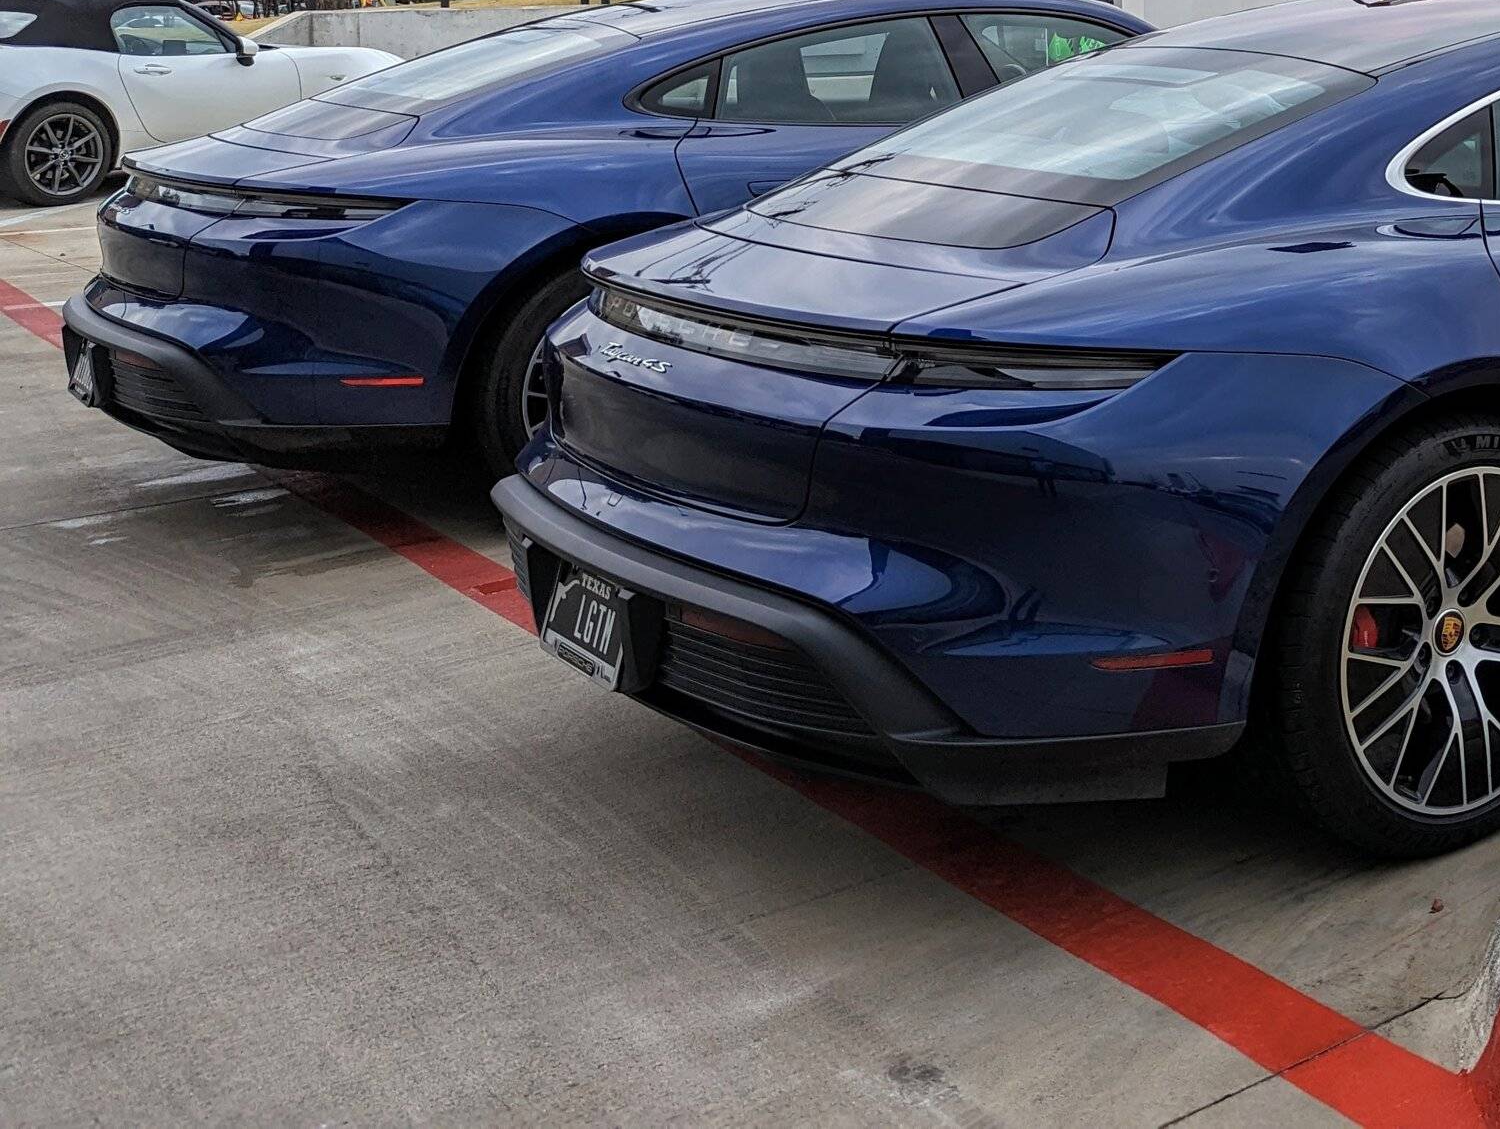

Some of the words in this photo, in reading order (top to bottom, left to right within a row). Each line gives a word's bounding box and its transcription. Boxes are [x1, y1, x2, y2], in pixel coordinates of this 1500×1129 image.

[606, 294, 753, 347] POCHE
[600, 342, 642, 366] Taycan
[581, 572, 612, 600] TEXAS
